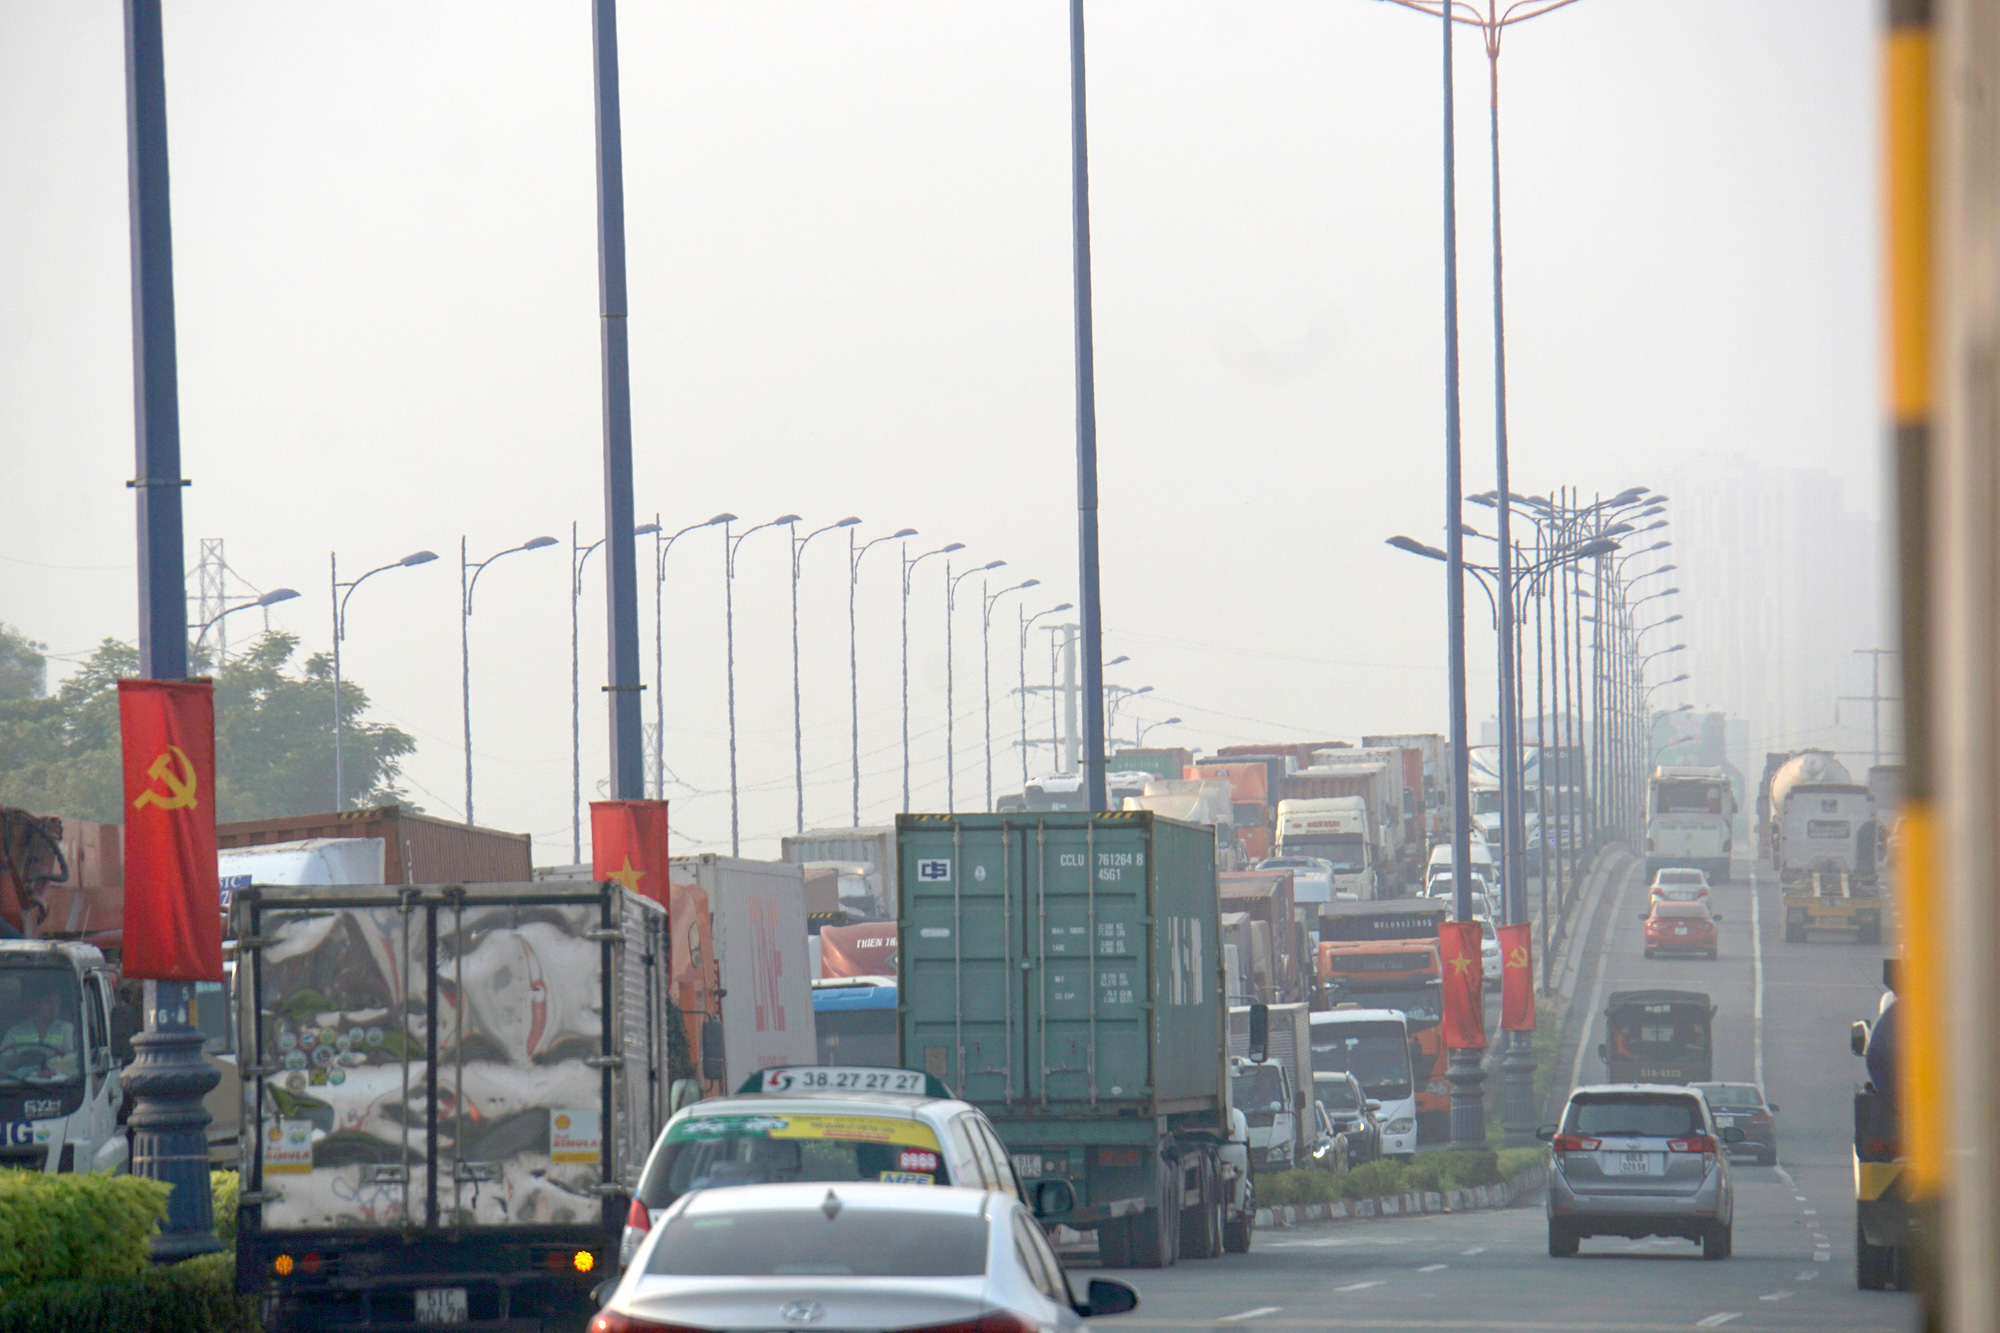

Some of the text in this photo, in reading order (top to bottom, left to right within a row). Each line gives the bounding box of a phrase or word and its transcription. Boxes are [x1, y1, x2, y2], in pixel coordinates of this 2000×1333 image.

[1060, 853, 1143, 866] CCLU 761264 8
[1098, 868, 1121, 880] 45G1
[885, 937, 898, 947] TH
[865, 1073, 890, 1088] 27
[895, 1074, 920, 1089] 27
